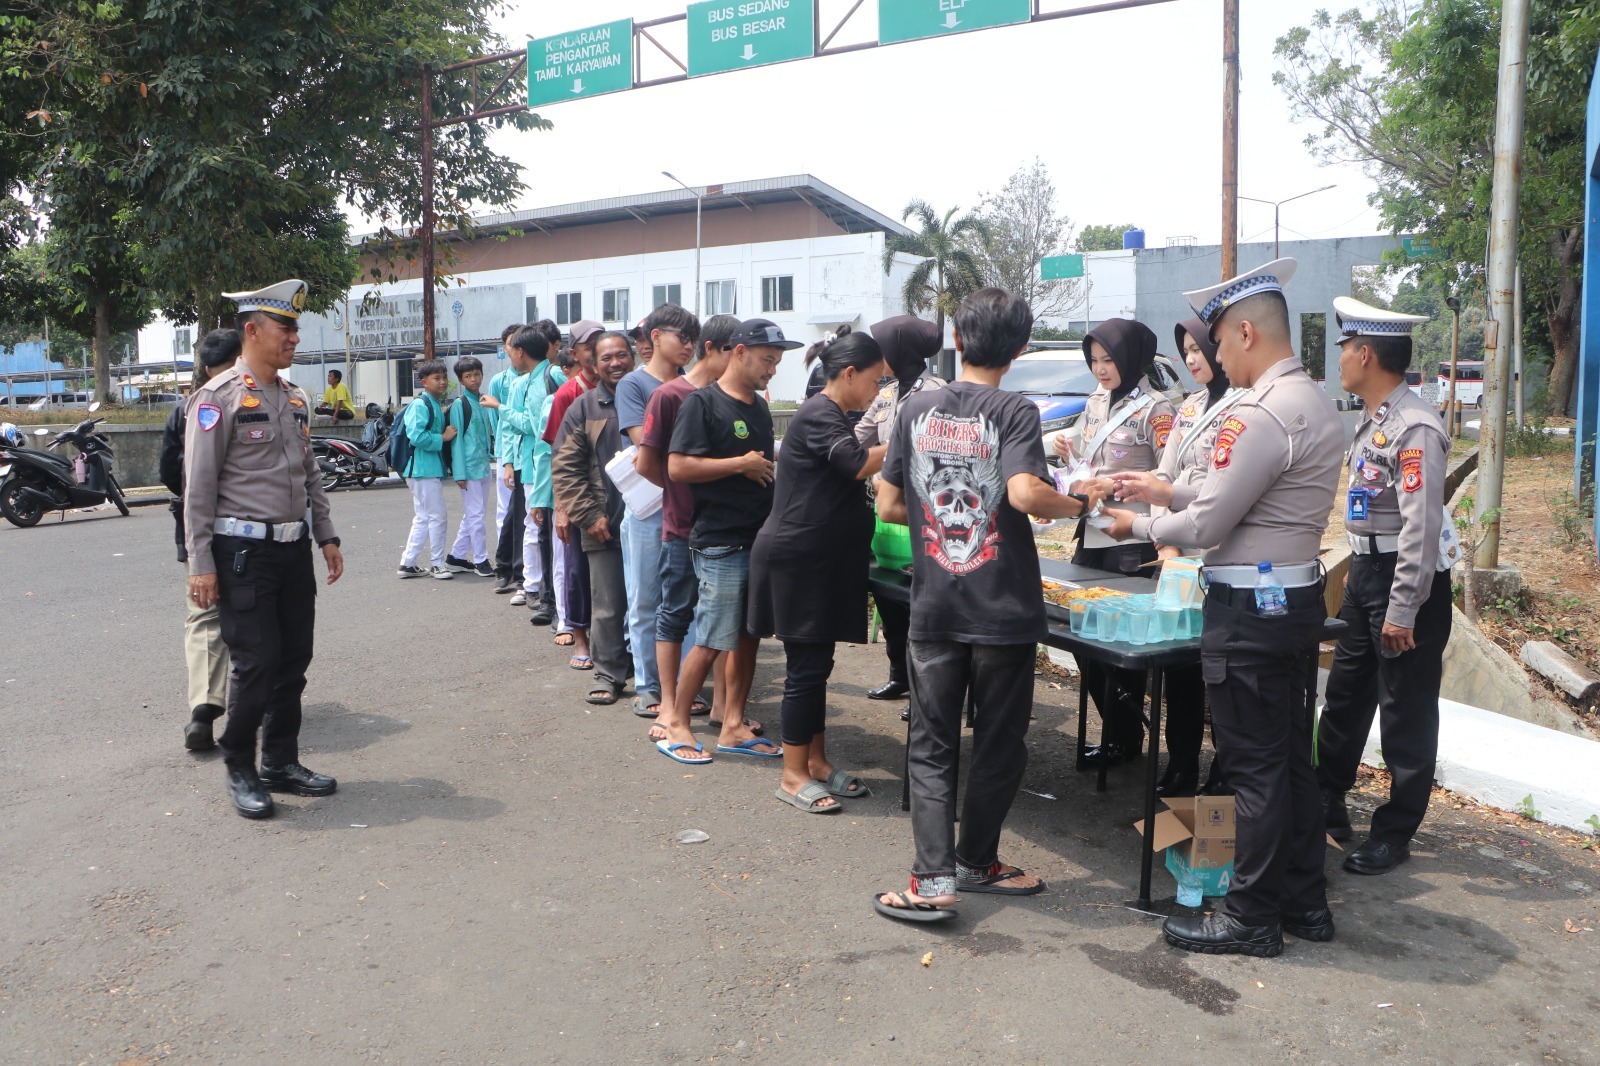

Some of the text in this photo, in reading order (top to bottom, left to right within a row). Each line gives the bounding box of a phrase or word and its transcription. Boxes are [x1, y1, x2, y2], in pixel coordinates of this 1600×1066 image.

[708, 7, 734, 24] BUS
[712, 16, 786, 42] BUS BESAR
[546, 42, 610, 66] PENGANTAR
[566, 53, 620, 76] KARYAWAN
[355, 301, 401, 319] TMINAL
[401, 327, 449, 344] KUNAN
[926, 417, 982, 443] BIKERS
[1120, 419, 1138, 430] LRI
[955, 556, 984, 572] JUBILEE
